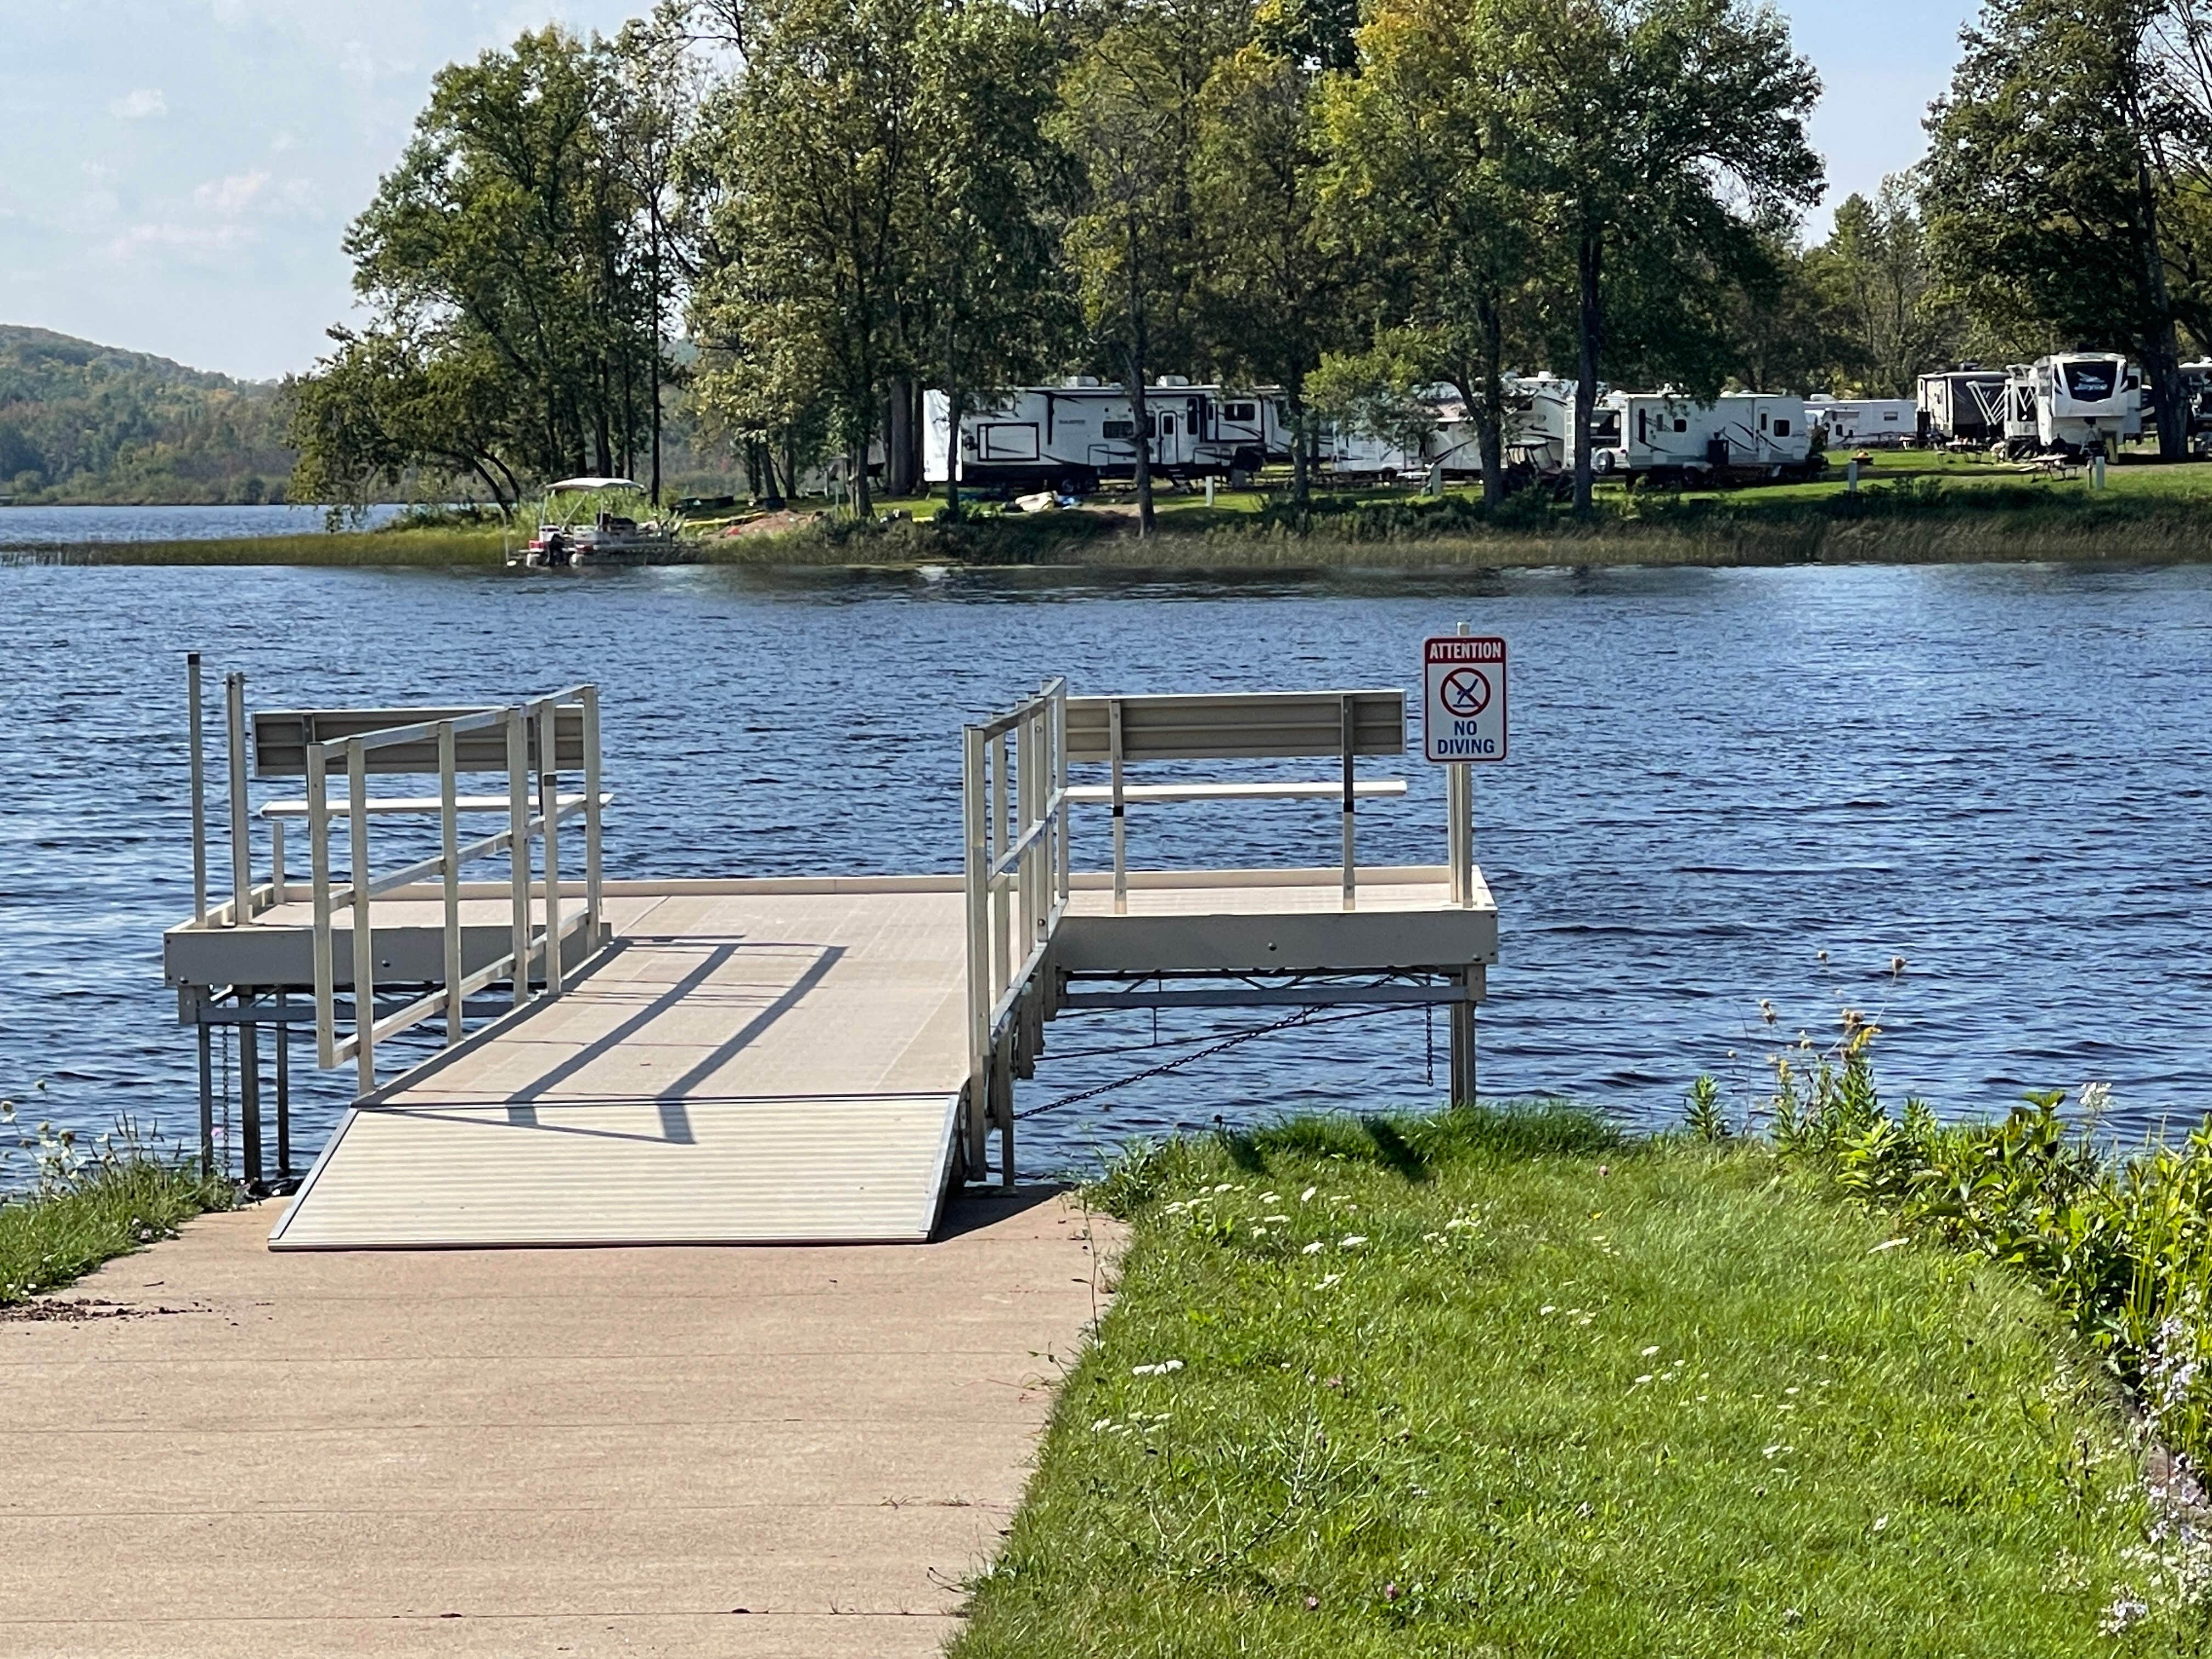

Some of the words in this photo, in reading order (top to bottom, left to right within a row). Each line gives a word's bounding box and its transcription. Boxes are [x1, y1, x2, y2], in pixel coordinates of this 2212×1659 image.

[1430, 642, 1502, 659] ATTENTION
[1454, 720, 1477, 736] NO
[1438, 738, 1495, 754] DIVING
